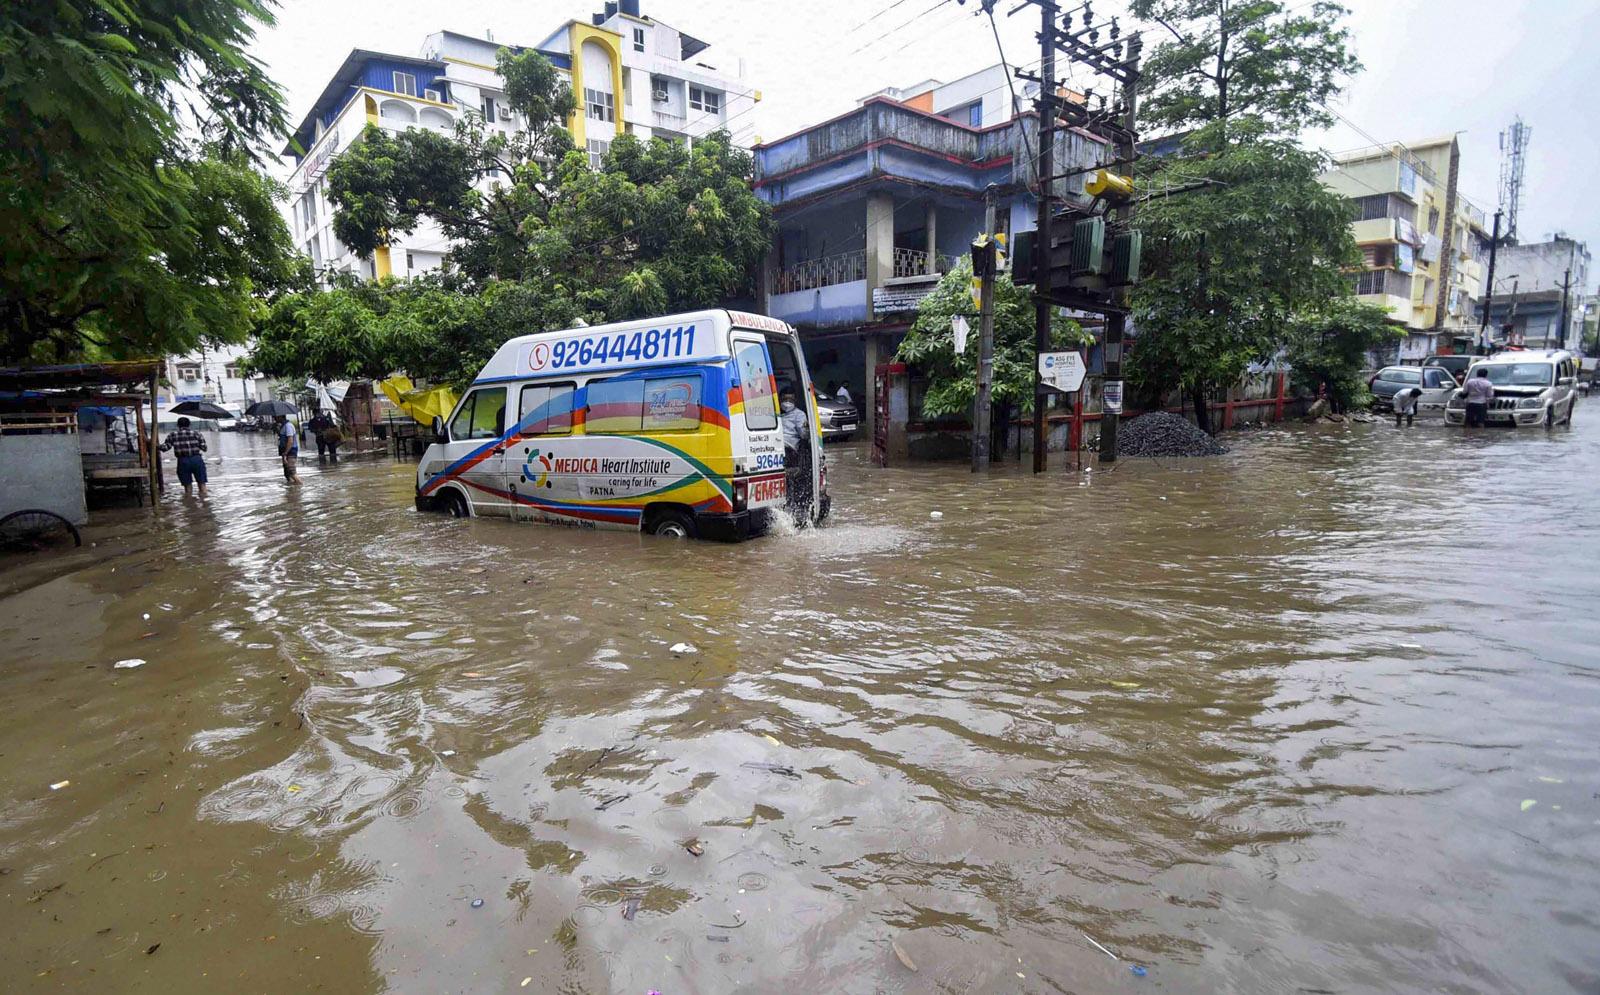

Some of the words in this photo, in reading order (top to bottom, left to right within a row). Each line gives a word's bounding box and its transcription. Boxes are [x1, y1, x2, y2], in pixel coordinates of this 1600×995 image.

[731, 313, 786, 332] AMBULANCE
[552, 325, 695, 368] 9264448111
[555, 458, 598, 473] MEDICA
[601, 458, 629, 473] Heart
[630, 458, 671, 474] Institute
[590, 486, 615, 496] PATNA
[608, 478, 631, 490] caring
[631, 476, 642, 487] for
[644, 476, 657, 488] life
